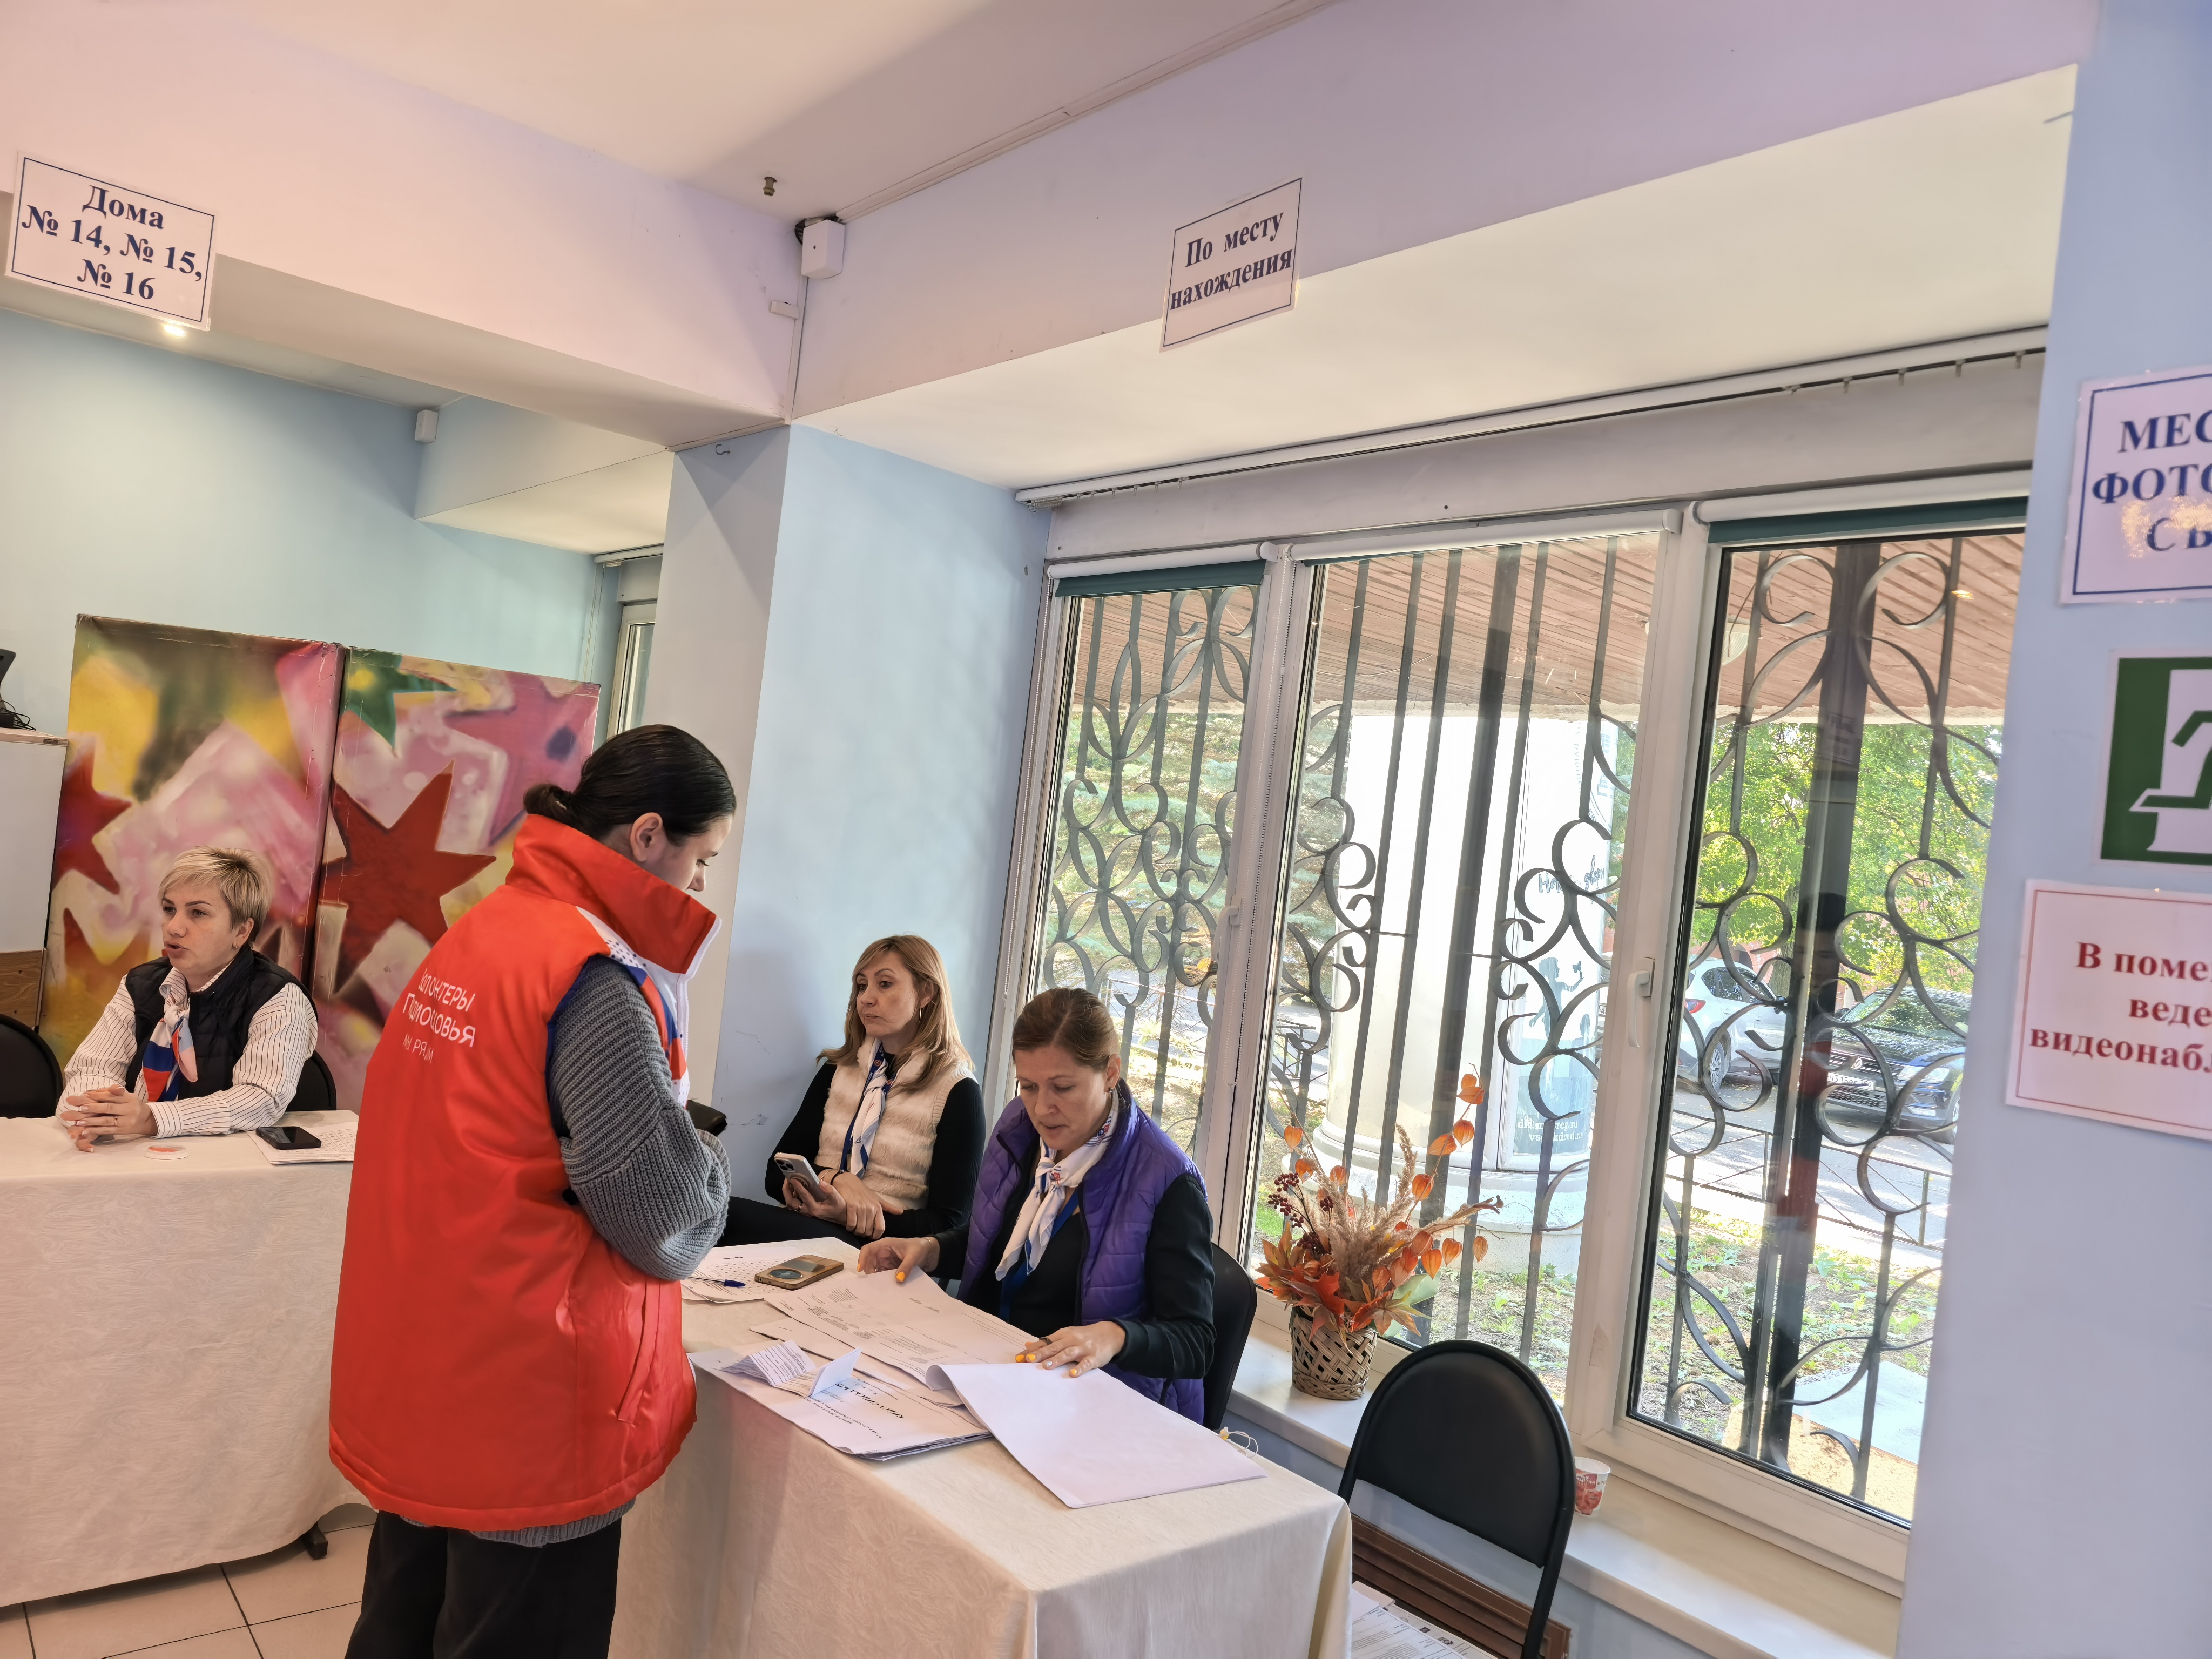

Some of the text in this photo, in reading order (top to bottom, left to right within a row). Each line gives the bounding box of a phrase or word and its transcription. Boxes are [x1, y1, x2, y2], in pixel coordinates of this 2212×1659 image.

[82, 185, 164, 230] Дома
[21, 204, 203, 282] № 14, № 15,
[1185, 212, 1284, 268] По месту
[76, 258, 156, 300] № 16
[1169, 248, 1293, 311] нахождения
[2146, 517, 2176, 552] С
[2076, 941, 2212, 982] В поме
[2128, 999, 2212, 1029] веде
[1518, 1117, 1578, 1130] dk.mreg.ru
[1576, 1476, 1596, 1485] ARTINI
